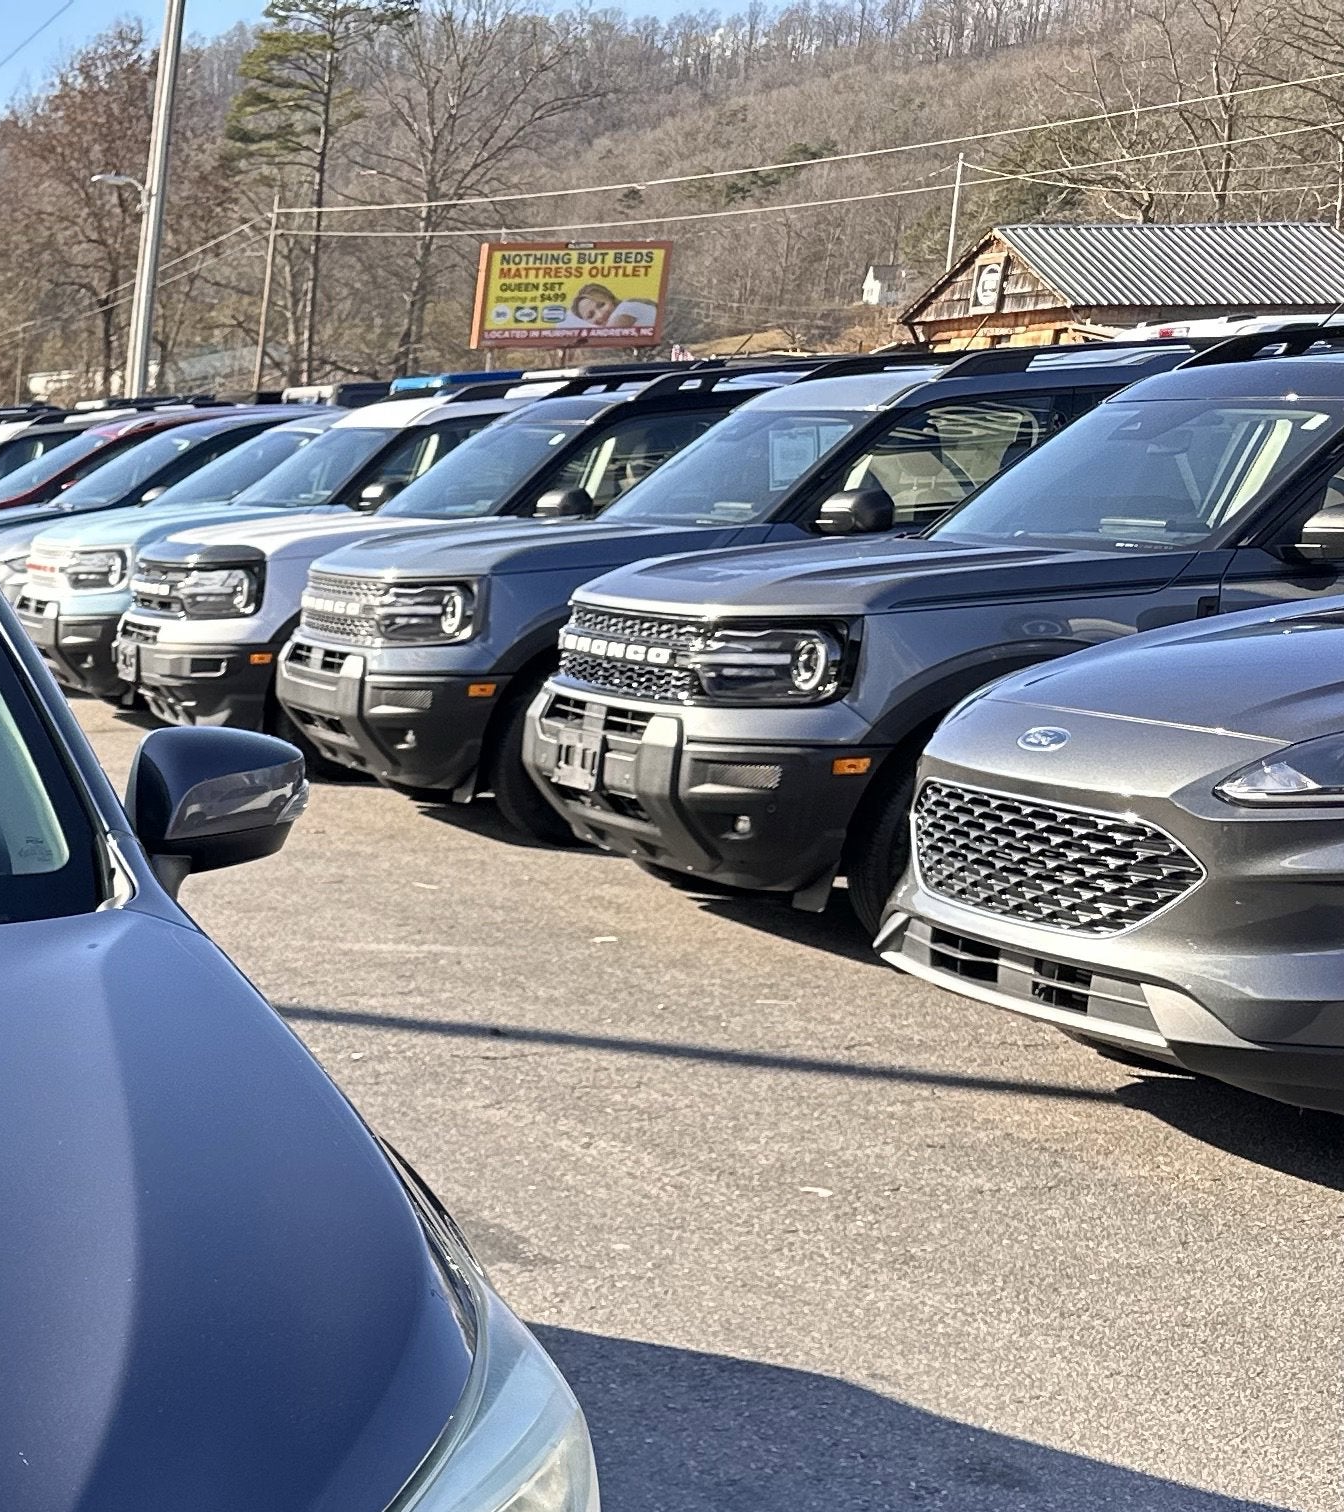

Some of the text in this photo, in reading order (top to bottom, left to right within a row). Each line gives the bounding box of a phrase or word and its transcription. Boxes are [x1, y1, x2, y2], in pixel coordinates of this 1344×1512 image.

[500, 251, 654, 265] NOTHING BUT BEDS
[499, 265, 651, 278] MATTRESS OUTLET
[499, 282, 564, 292] QUEEN SET
[484, 330, 528, 339] LOCATED
[529, 330, 540, 338] IN
[639, 327, 654, 337] NC
[563, 634, 672, 664] BRONCO
